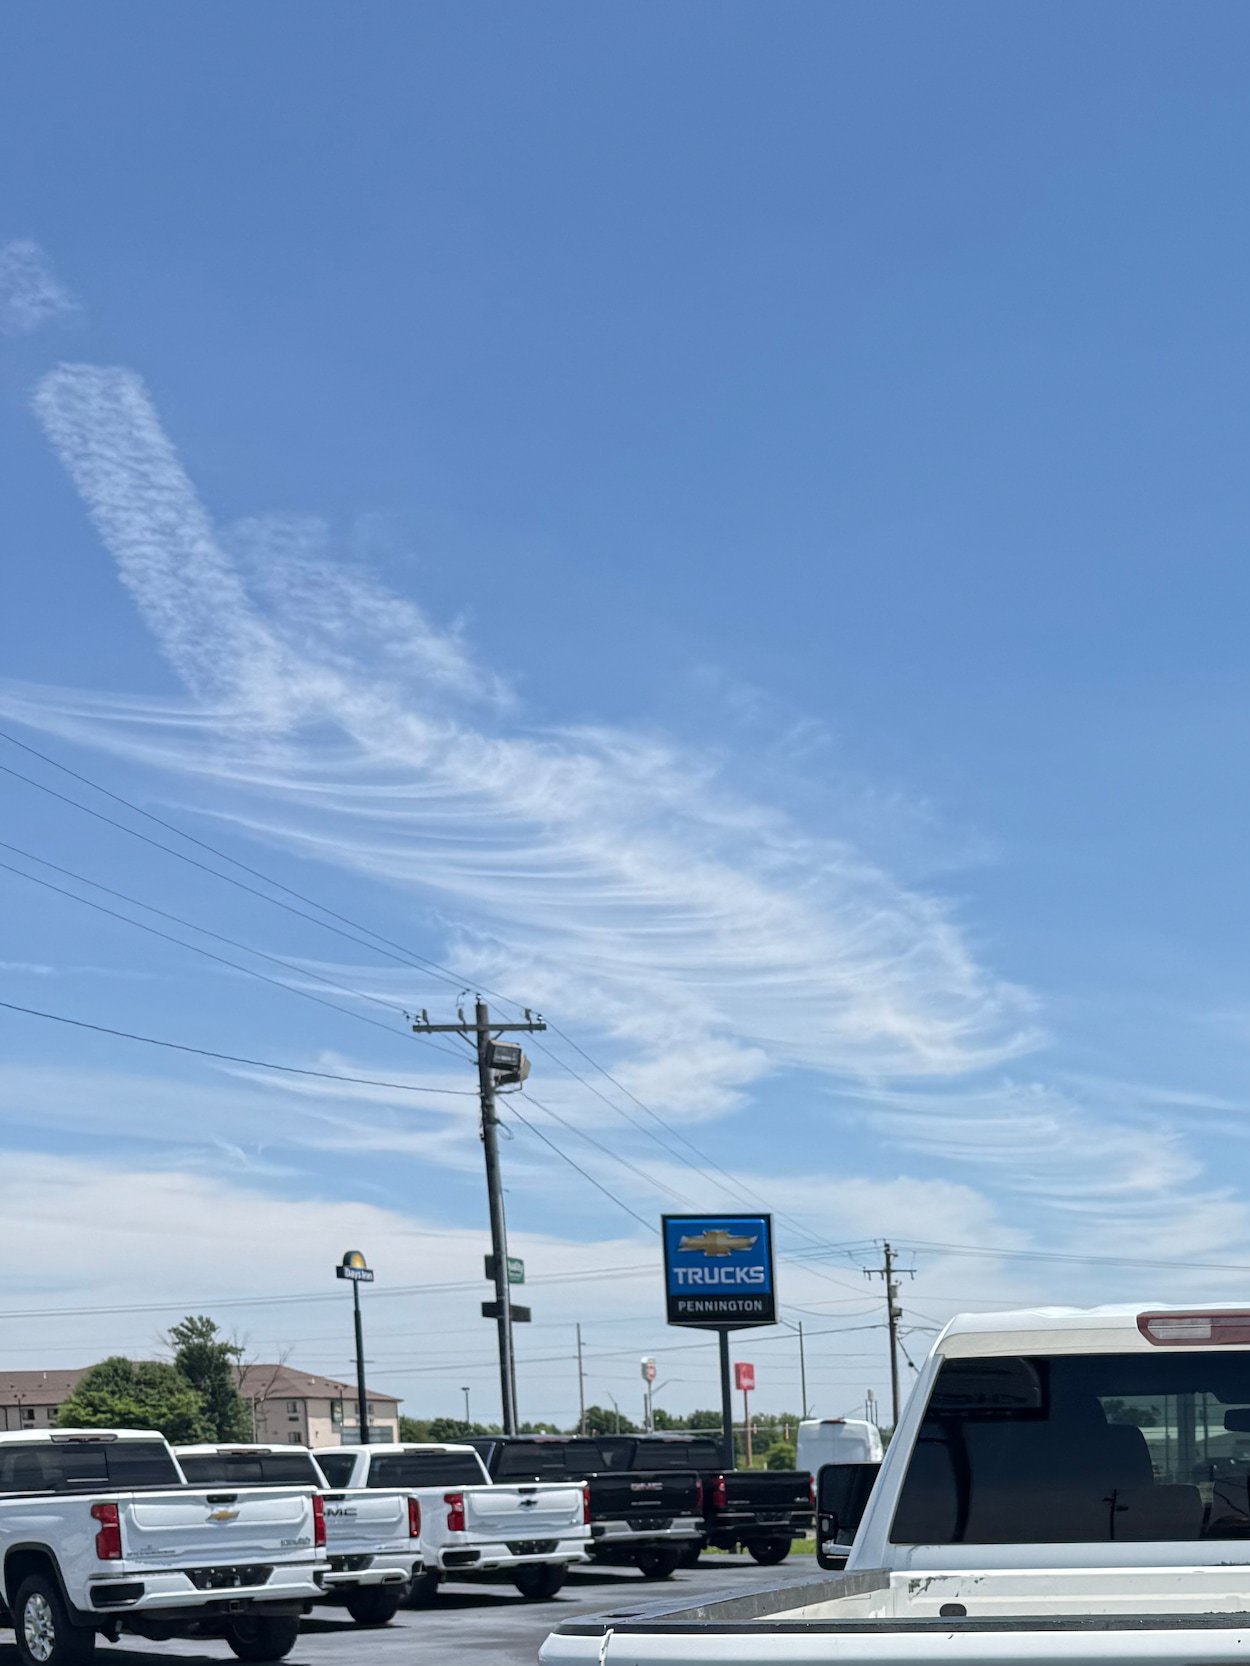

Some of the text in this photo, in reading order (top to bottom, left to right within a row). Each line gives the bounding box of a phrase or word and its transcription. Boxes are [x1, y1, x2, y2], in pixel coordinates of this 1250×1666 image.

[673, 1265, 765, 1285] TRUCKS
[677, 1300, 763, 1312] PENNINGTON
[323, 1508, 358, 1517] MC
